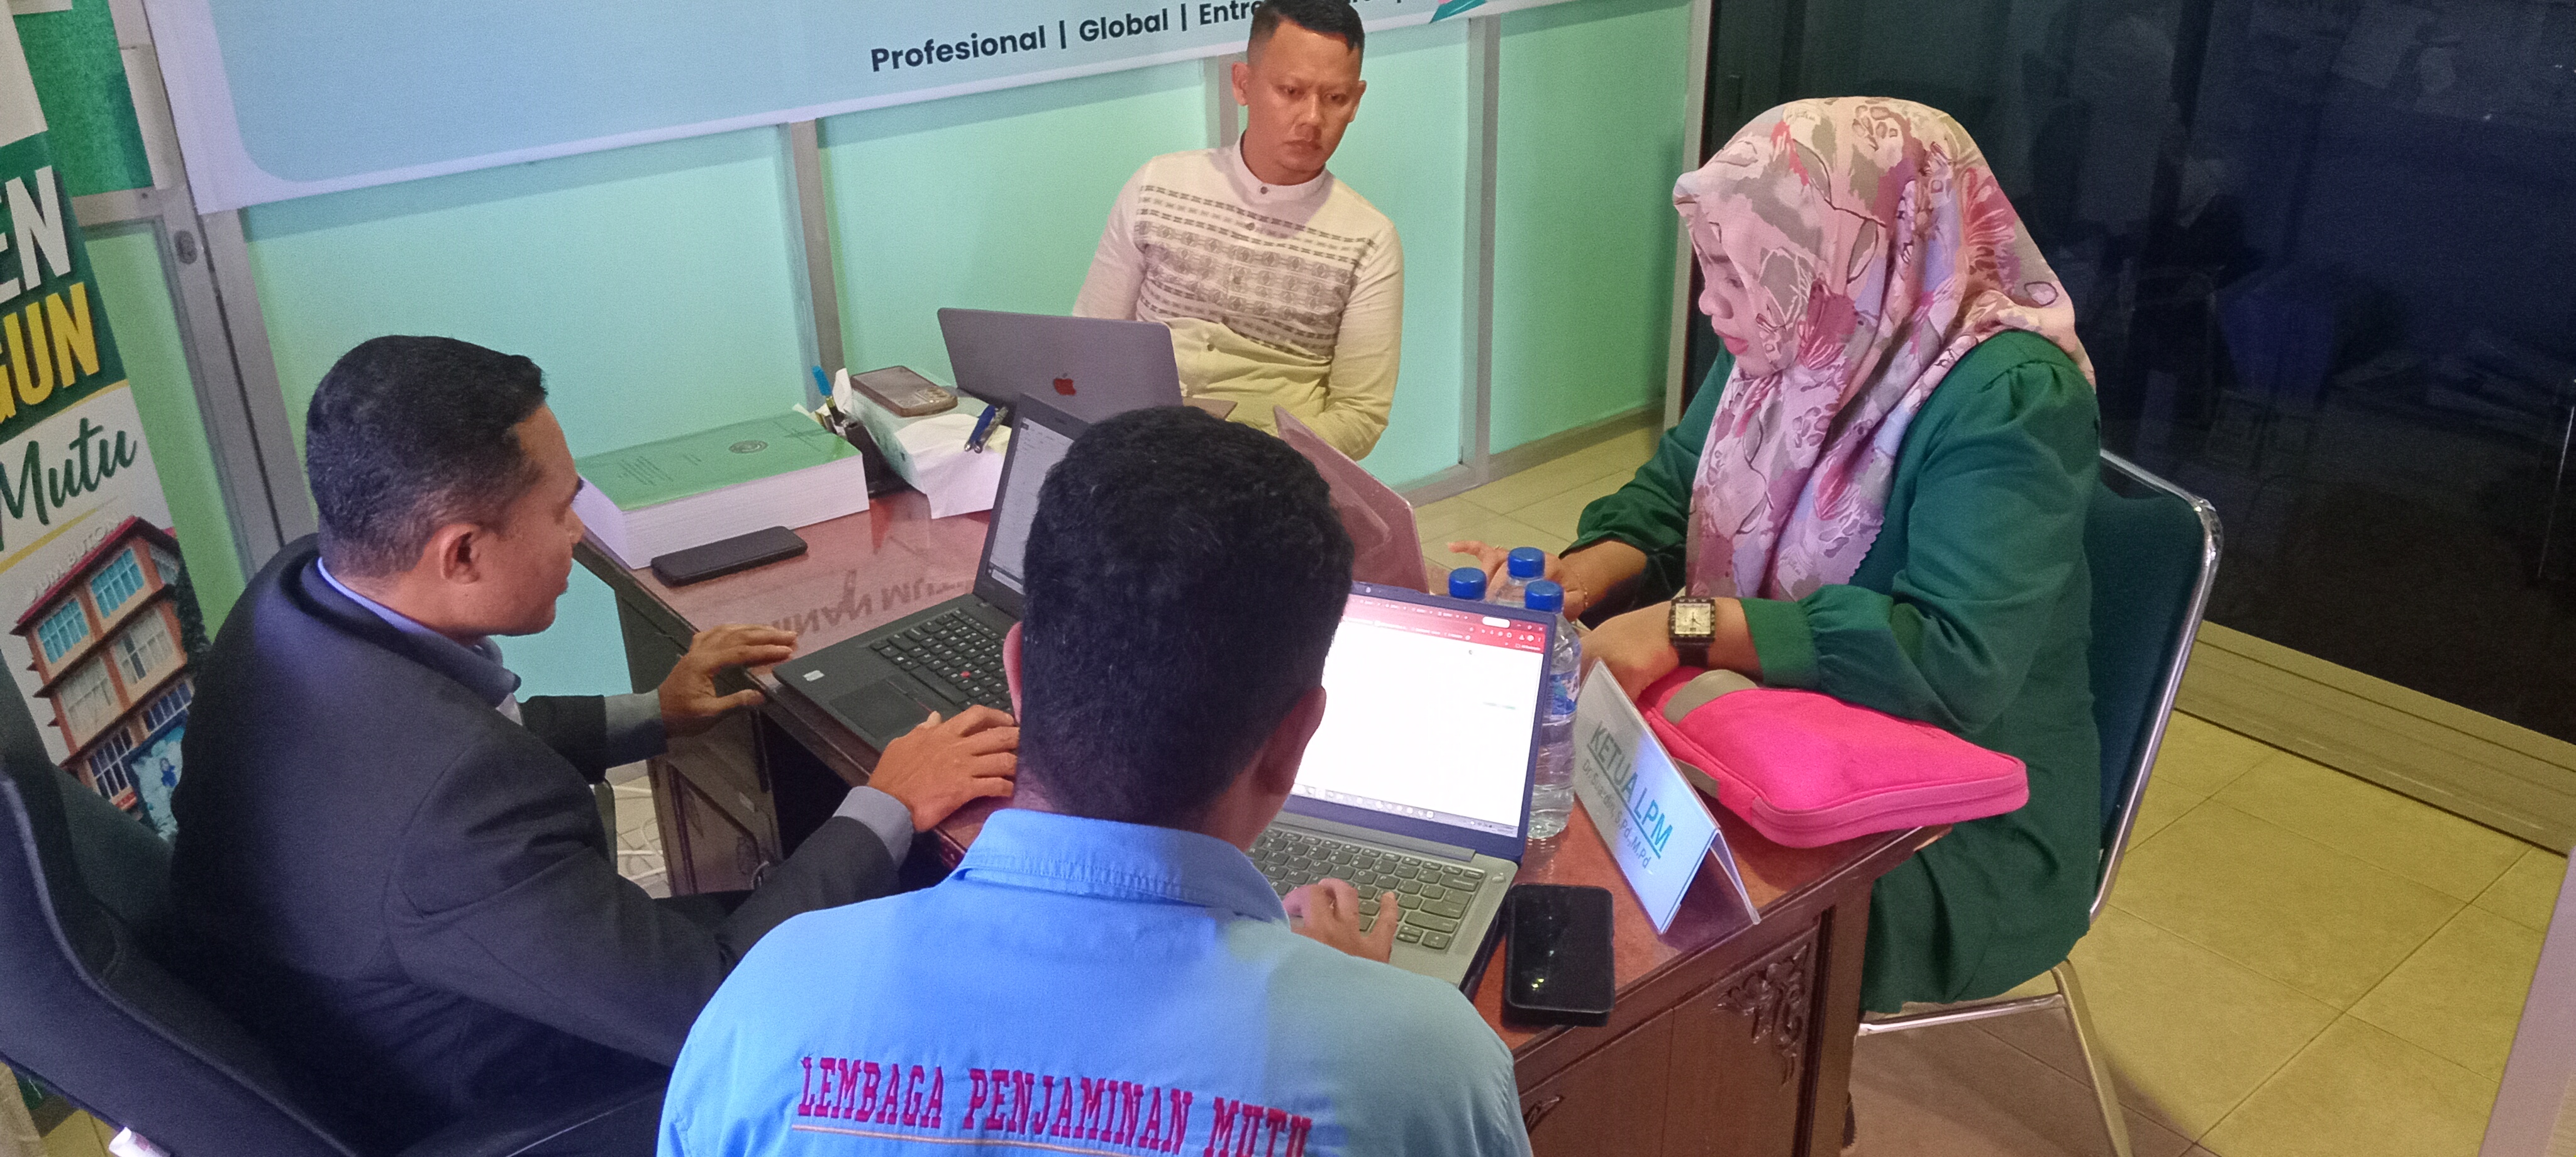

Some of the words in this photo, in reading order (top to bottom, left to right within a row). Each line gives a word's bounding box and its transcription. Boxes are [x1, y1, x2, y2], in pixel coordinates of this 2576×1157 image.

[870, 25, 1046, 72] Profesional
[1079, 8, 1169, 42] Global
[0, 417, 137, 551] Mutu
[1582, 758, 1593, 778] Dr.
[1590, 721, 1639, 803] KETUA
[1634, 787, 1674, 853] LPM
[797, 1055, 943, 1128] LEMBAGA
[963, 1068, 1192, 1155] PENJAMINAN
[1203, 1097, 1313, 1157] MUTU
